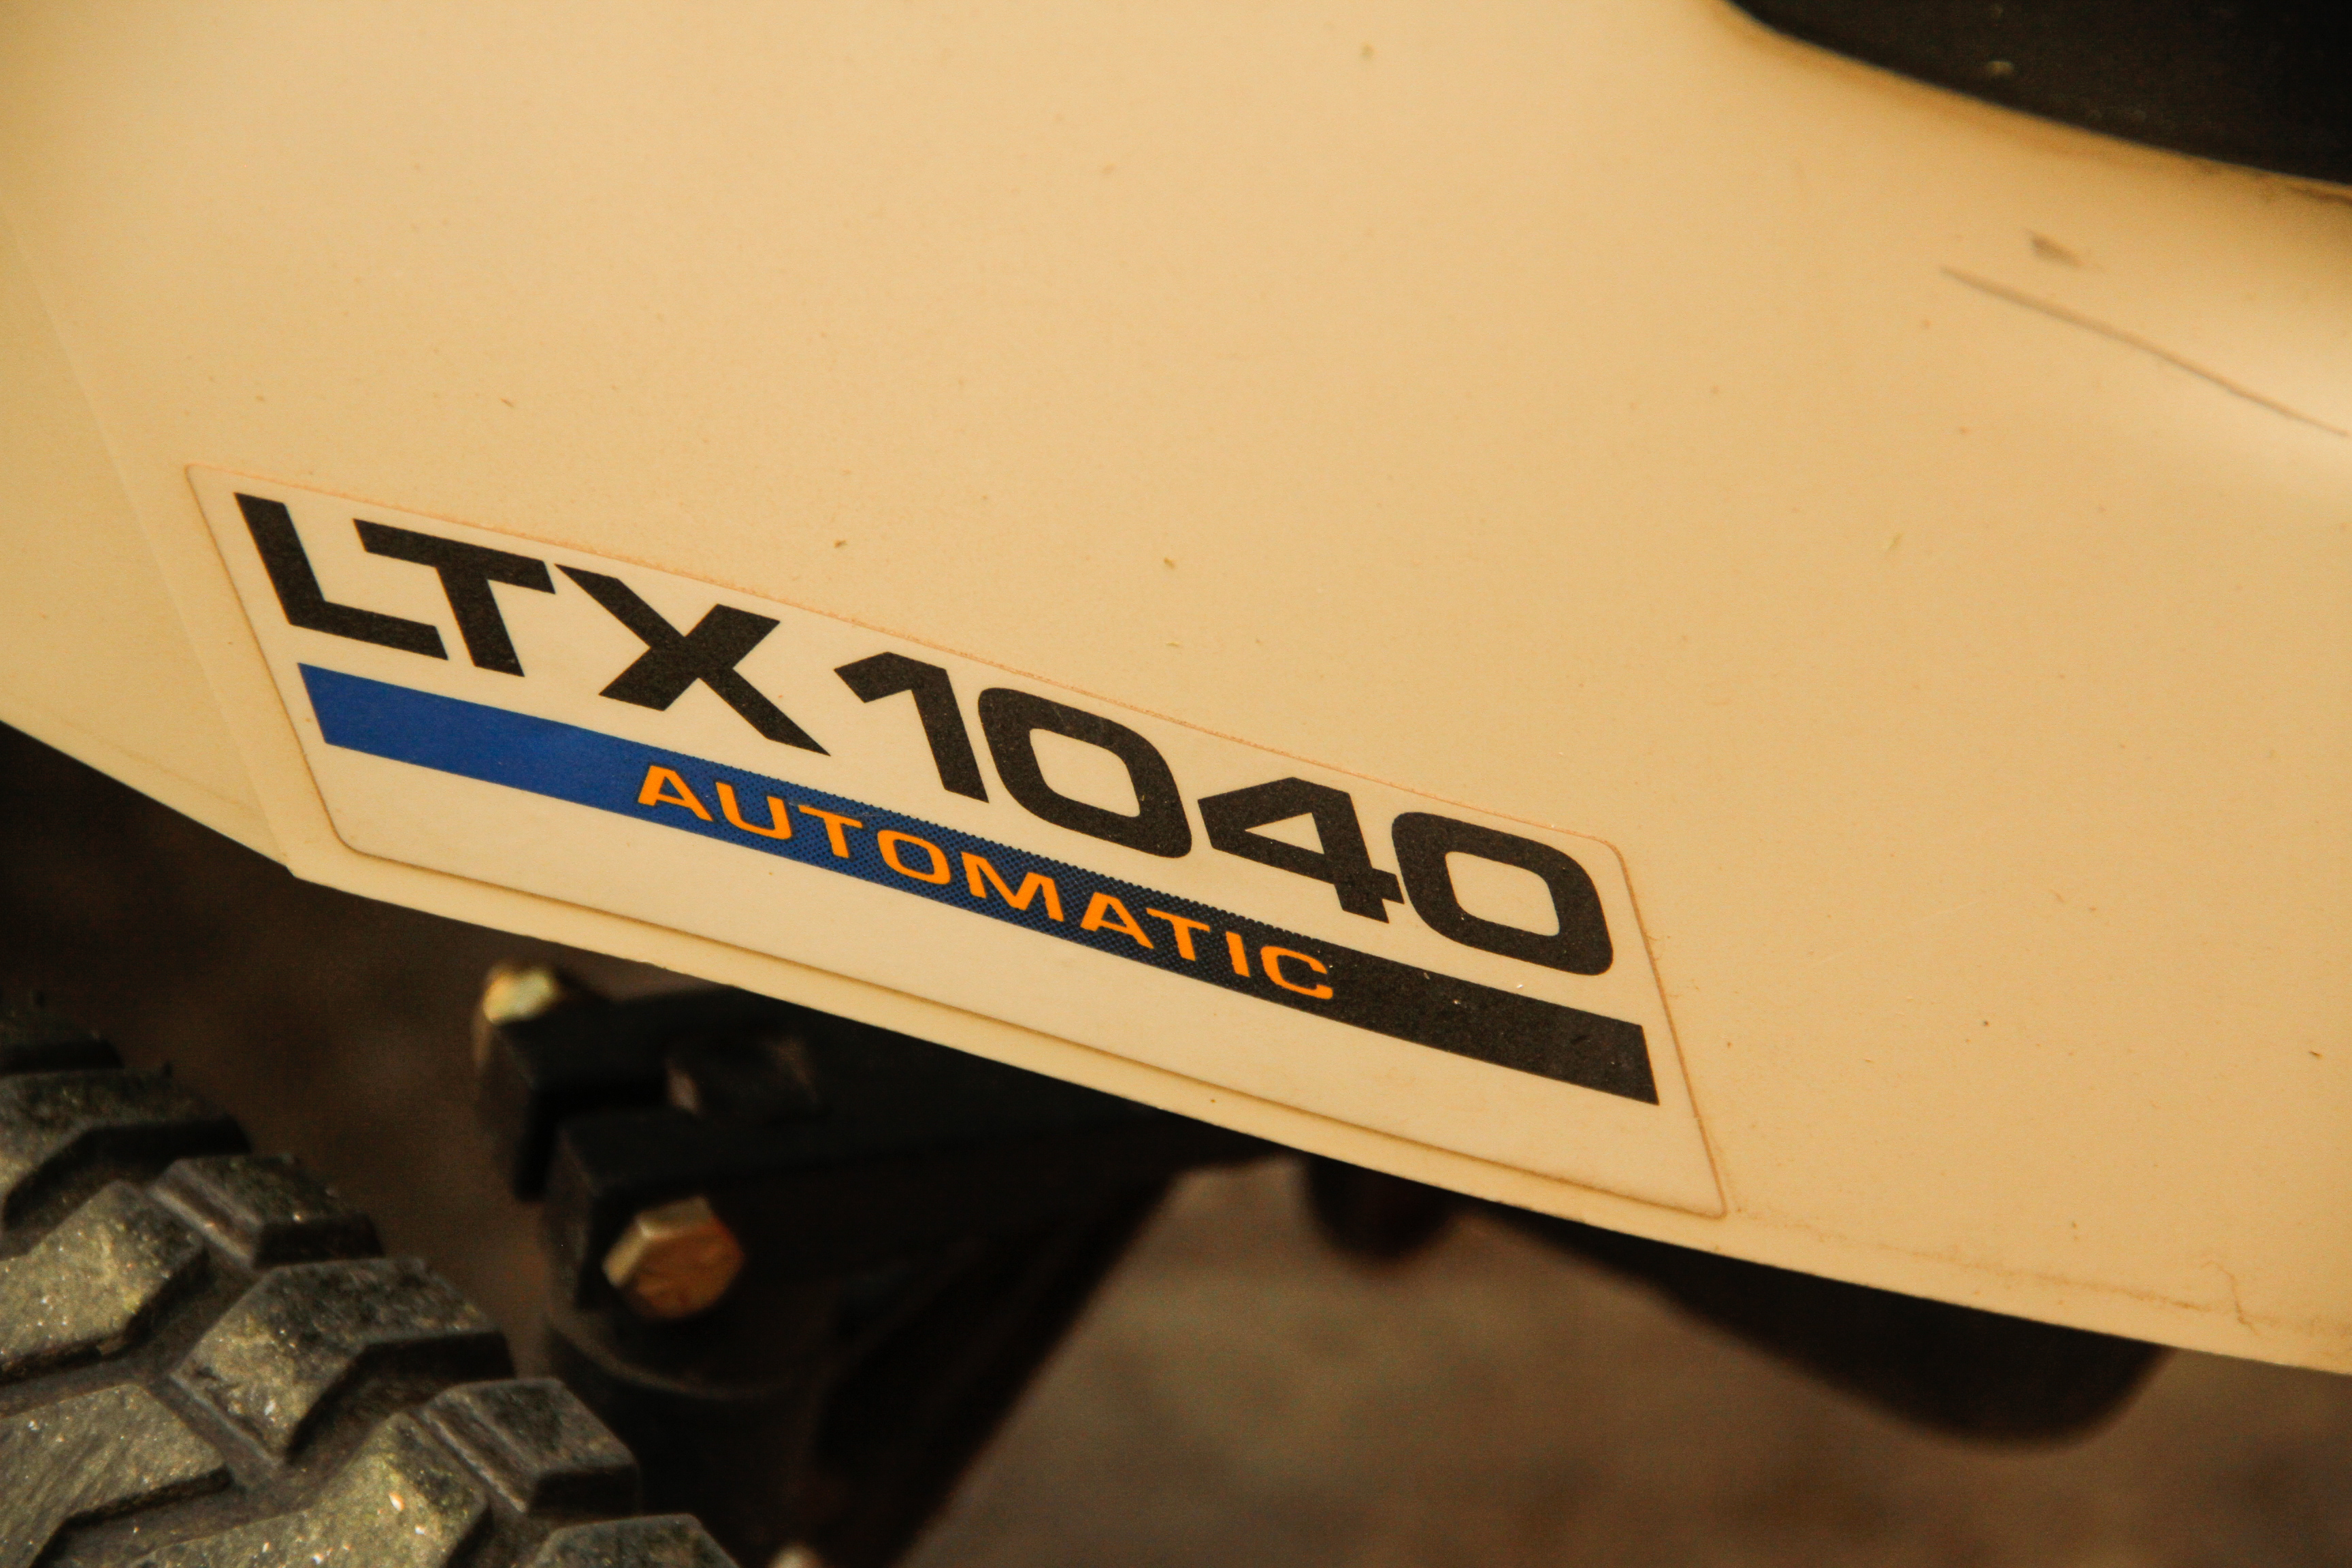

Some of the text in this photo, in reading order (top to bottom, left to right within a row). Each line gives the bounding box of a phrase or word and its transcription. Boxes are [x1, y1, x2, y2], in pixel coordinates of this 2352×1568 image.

[234, 491, 1614, 977] LTX 1040
[638, 765, 1335, 1000] AUTOMATIC
